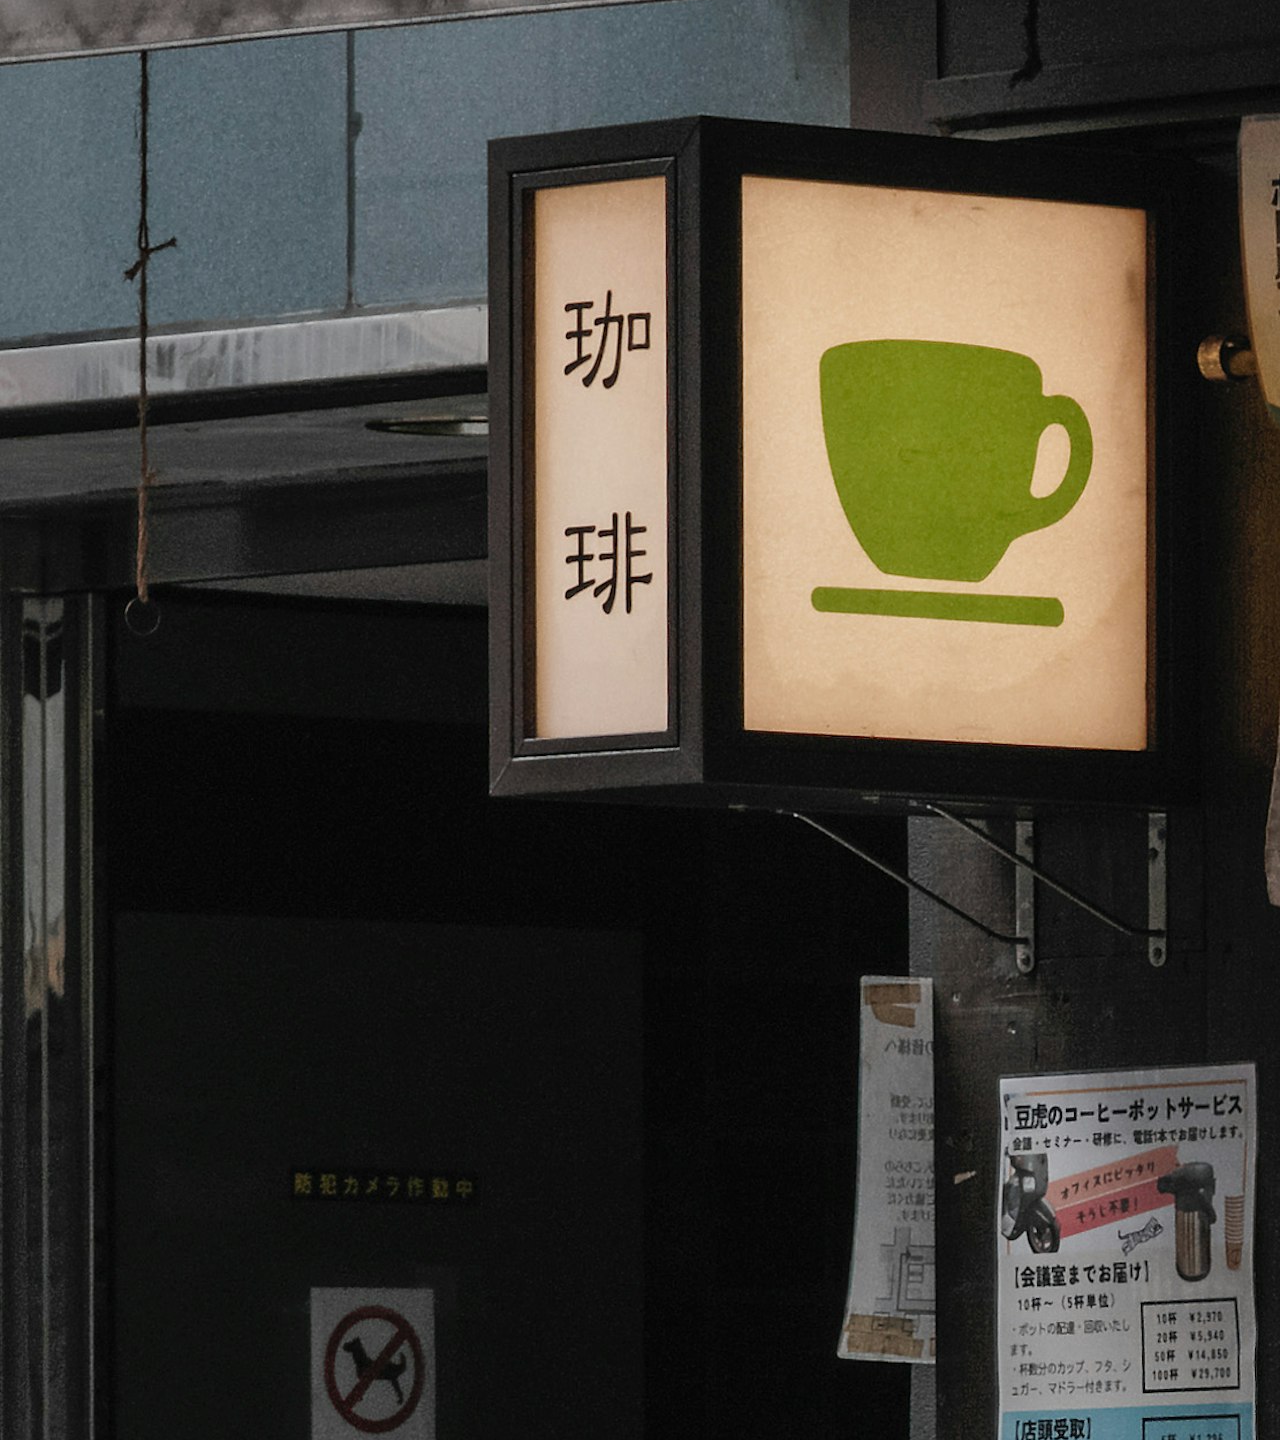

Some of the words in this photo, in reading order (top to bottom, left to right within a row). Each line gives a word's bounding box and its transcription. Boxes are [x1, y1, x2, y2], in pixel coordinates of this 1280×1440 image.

[565, 291, 653, 614] 珈琲
[1014, 1094, 1243, 1130] 豆虎のコーヒーポットサービス
[1061, 1161, 1157, 1200] オフィスにピッタリ
